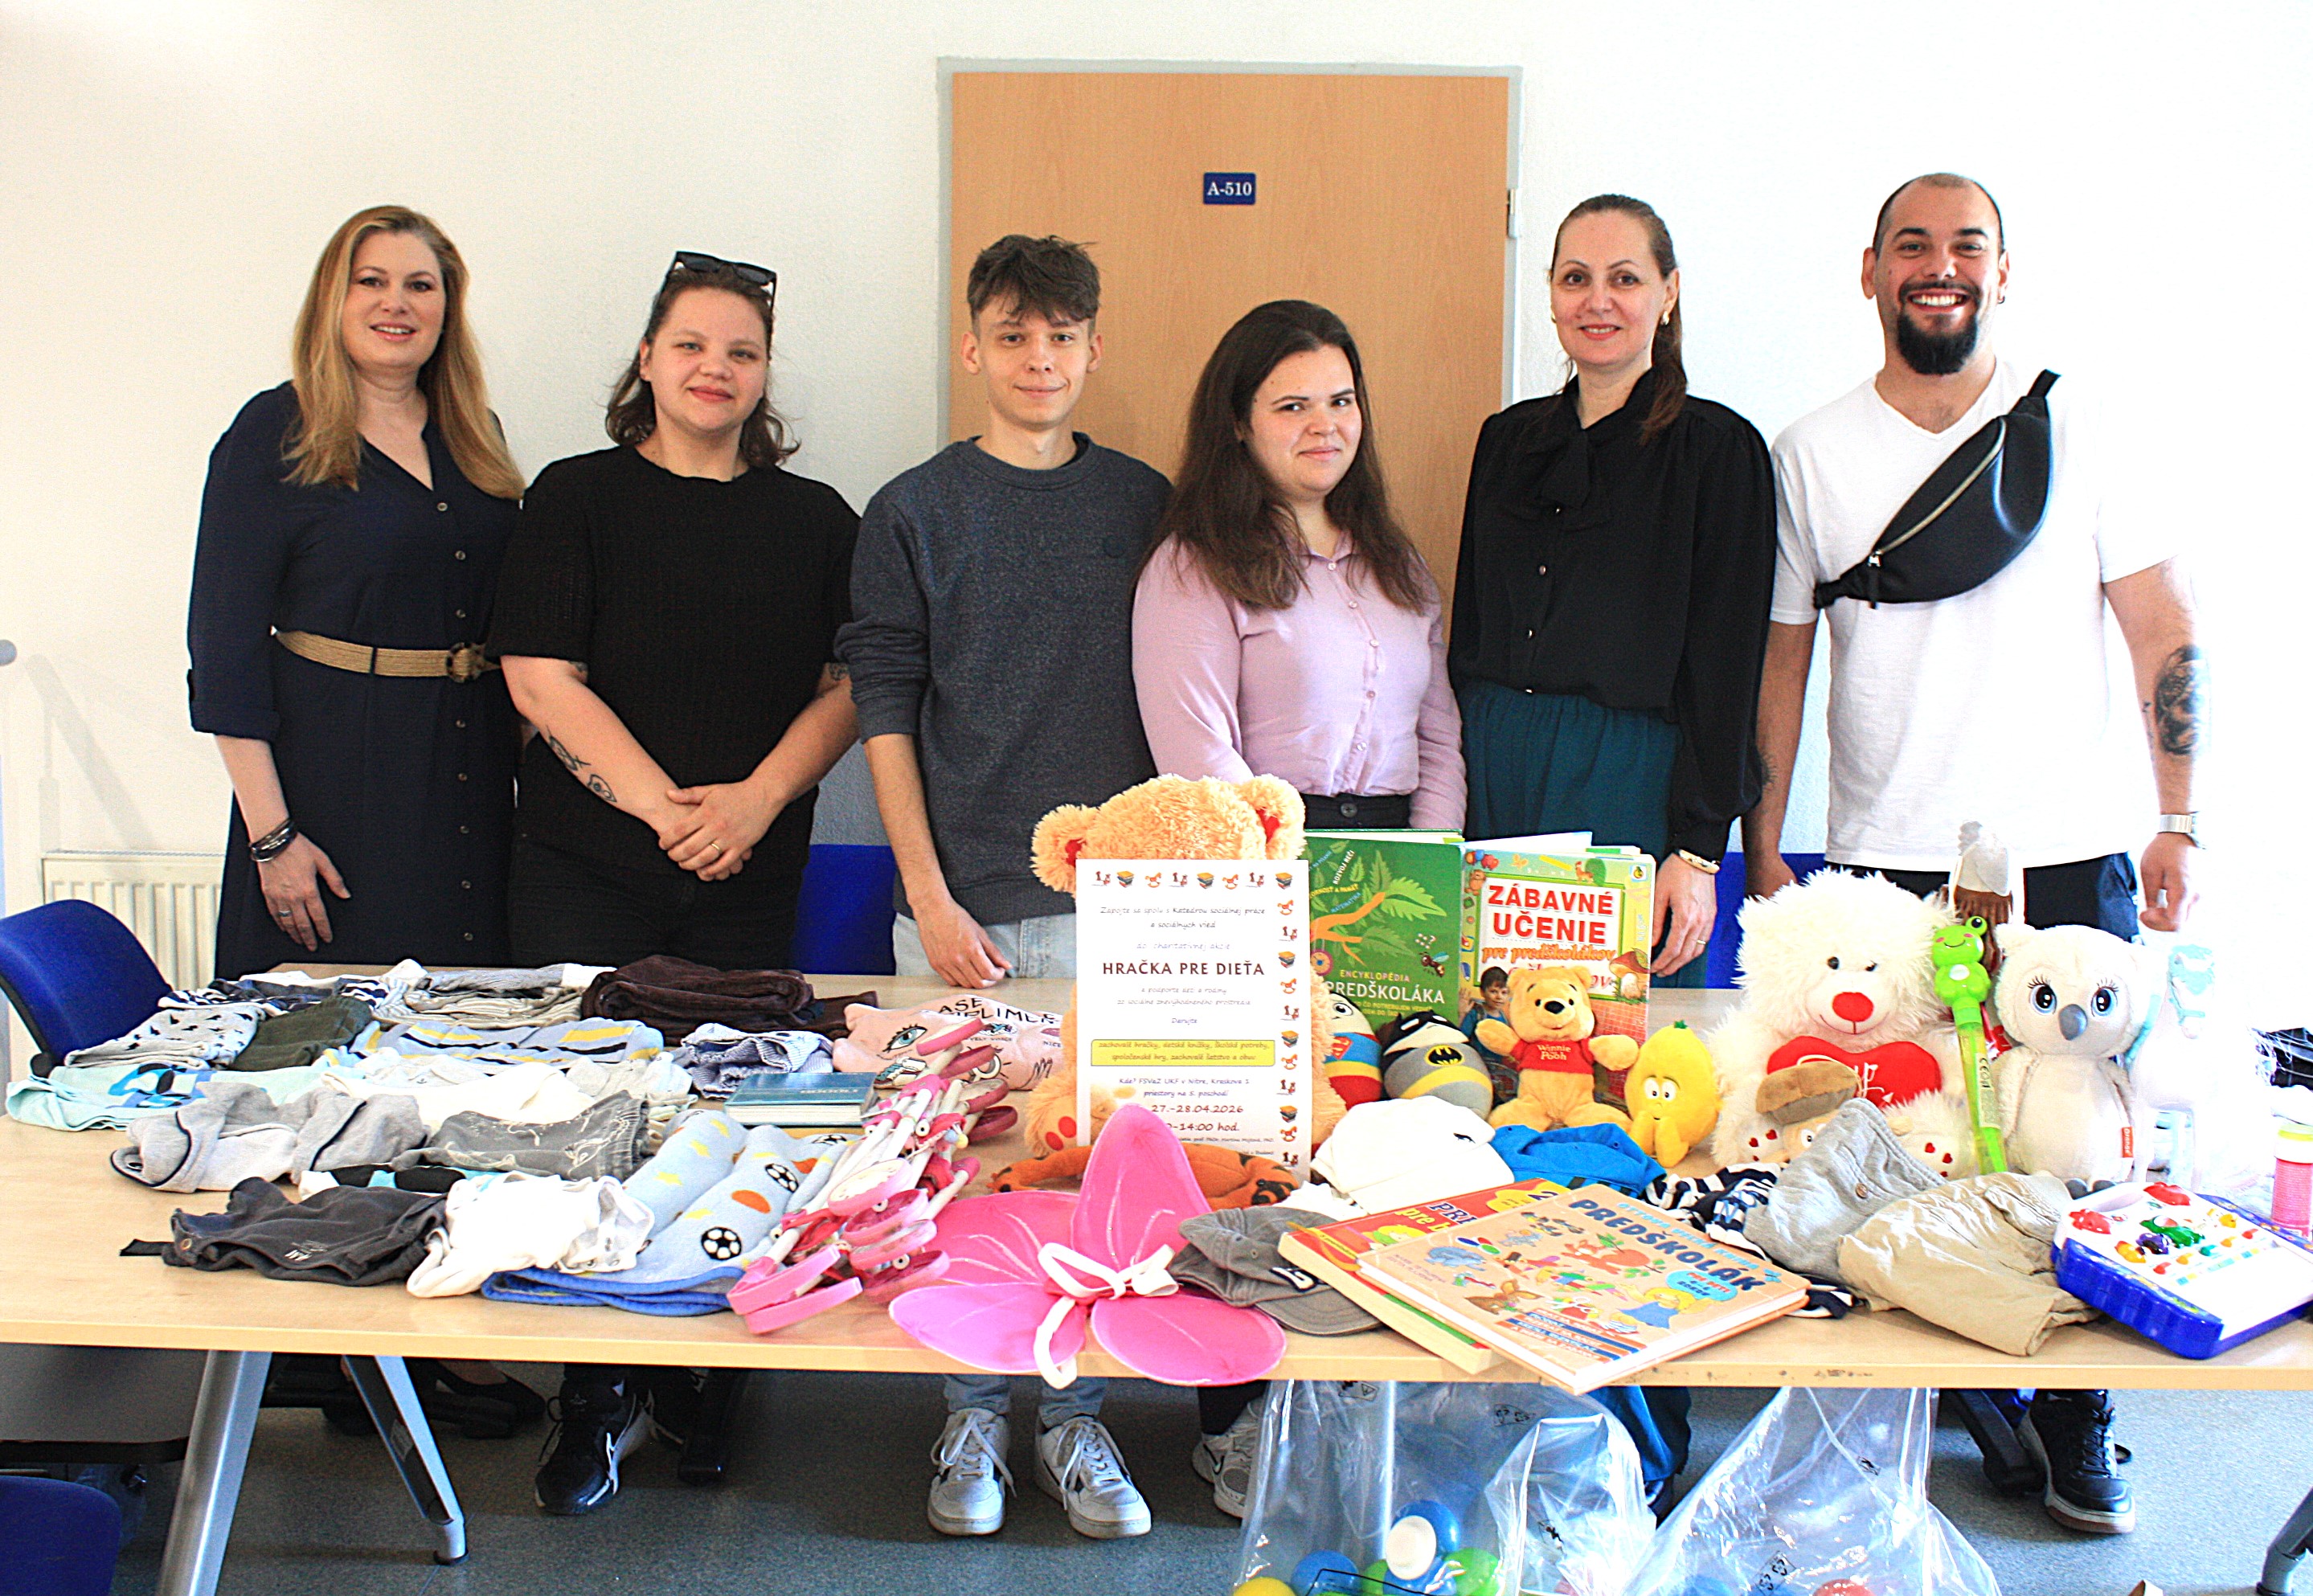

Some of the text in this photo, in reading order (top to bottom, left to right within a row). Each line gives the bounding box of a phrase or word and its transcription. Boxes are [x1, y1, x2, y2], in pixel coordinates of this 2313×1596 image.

[1207, 182, 1252, 196] A-510
[1333, 849, 1356, 885] ROZVOJ REČI
[1488, 883, 1614, 916] ZÁBAVNÉ
[1100, 906, 1130, 915] Zapojte
[1144, 907, 1164, 915] spolu
[1210, 907, 1242, 916] sociálnej
[1245, 908, 1266, 916] práce
[1158, 921, 1197, 931] sociálnych
[1199, 920, 1217, 928] vied
[1493, 911, 1607, 945] UČENIE
[1482, 943, 1617, 964] pre predškolákov
[1102, 959, 1266, 976] HRAČKA PRE DIEŤA
[1340, 969, 1410, 983] ENCYKLOPÉDIA
[1325, 980, 1445, 1005] PREDŠKOLÁKA
[939, 997, 982, 1013] ASE
[1171, 1017, 1198, 1025] Darujte
[1537, 1044, 1572, 1053] Winnie
[1112, 1054, 1152, 1062] spoločenské
[1541, 1051, 1567, 1061] Pooh
[1189, 1078, 1209, 1086] Nitre,
[1143, 1090, 1175, 1099] priestory
[1198, 1090, 1230, 1099] poschodí
[1151, 1104, 1244, 1114] 27.-28.04.2026
[1166, 1122, 1240, 1132] -14:00 hod.
[1394, 1208, 1435, 1225] pre
[1430, 1202, 1477, 1224] PRI
[1617, 1202, 1672, 1229] OTTOVA
[1568, 1198, 1766, 1292] PREDŠKOLÁK
